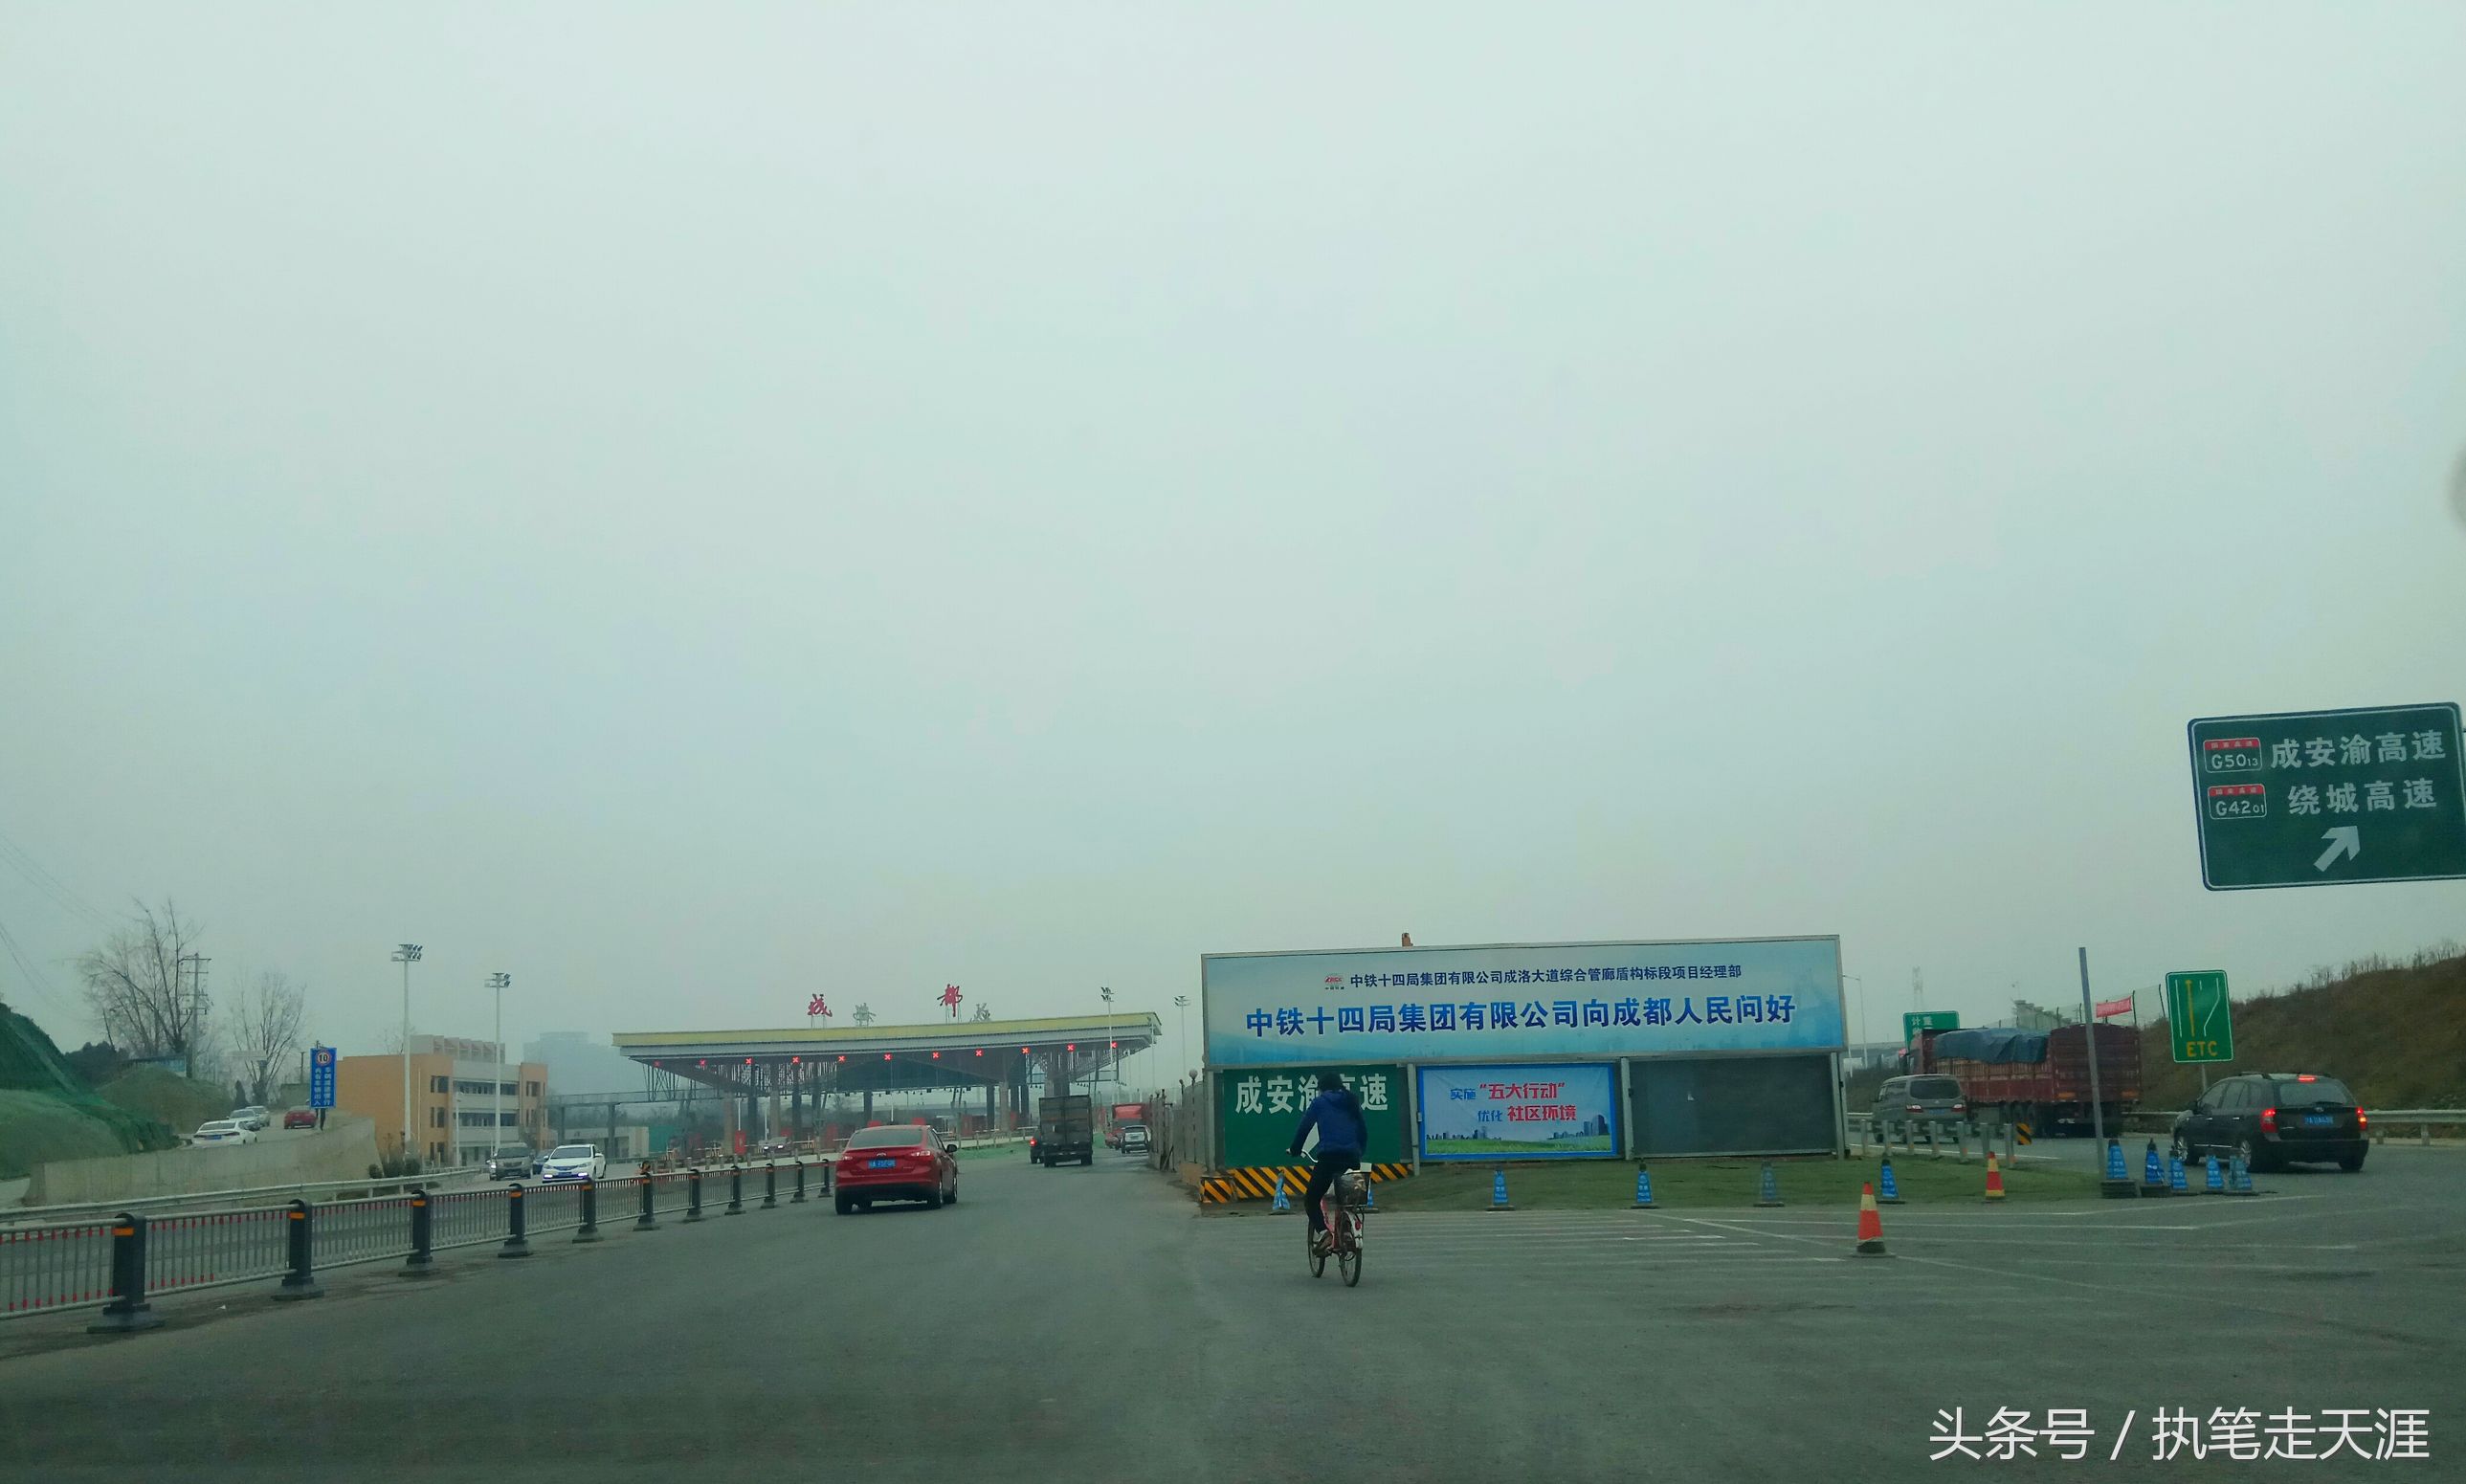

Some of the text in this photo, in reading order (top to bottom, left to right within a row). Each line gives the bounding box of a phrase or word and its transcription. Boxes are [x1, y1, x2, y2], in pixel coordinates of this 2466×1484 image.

[2270, 729, 2447, 769] 成安渝高速
[2211, 753, 2258, 769] G5013
[2287, 777, 2438, 816] 绕城高速
[2215, 800, 2265, 816] G4201
[1350, 964, 1742, 988] 中铁十四局集团有限公司成洛大道综合管廊盾构标段项目经理部
[1245, 994, 1796, 1038] 中铁十四局集团有限公司向成都人民问好
[2186, 1040, 2218, 1057] ETC
[1235, 1073, 1389, 1115] 成安渝速
[1450, 1088, 1477, 1100] 实施
[1477, 1105, 1577, 1122] 优化 社区环境
